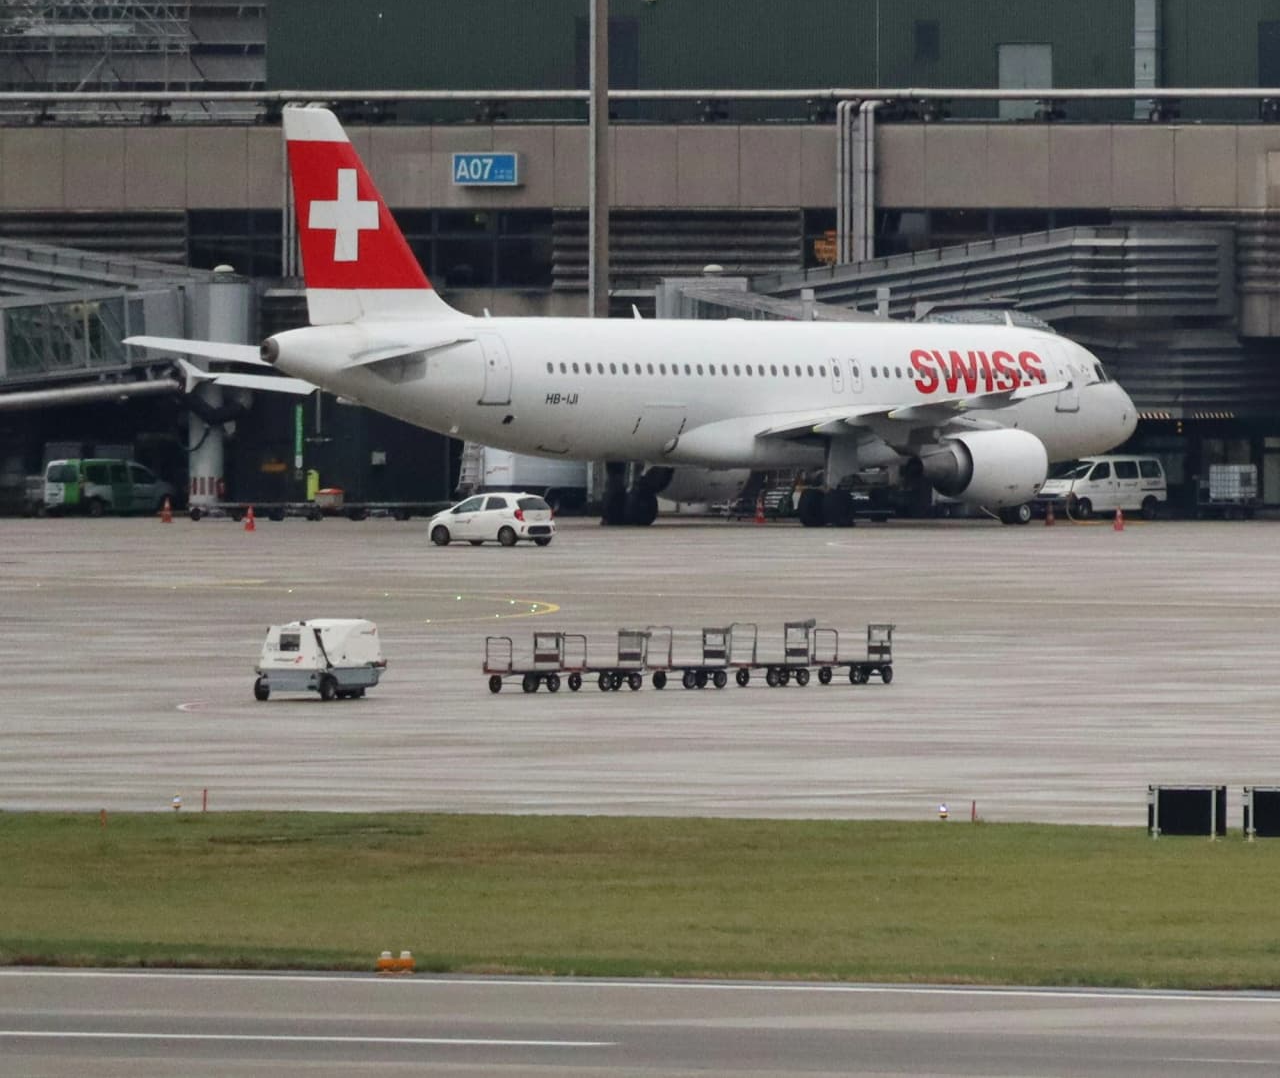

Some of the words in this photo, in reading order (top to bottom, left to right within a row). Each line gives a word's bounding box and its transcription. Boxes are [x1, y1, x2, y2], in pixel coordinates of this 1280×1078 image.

[456, 158, 494, 181] A07
[910, 349, 1048, 394] SWISS
[545, 393, 579, 404] HB-IJI
